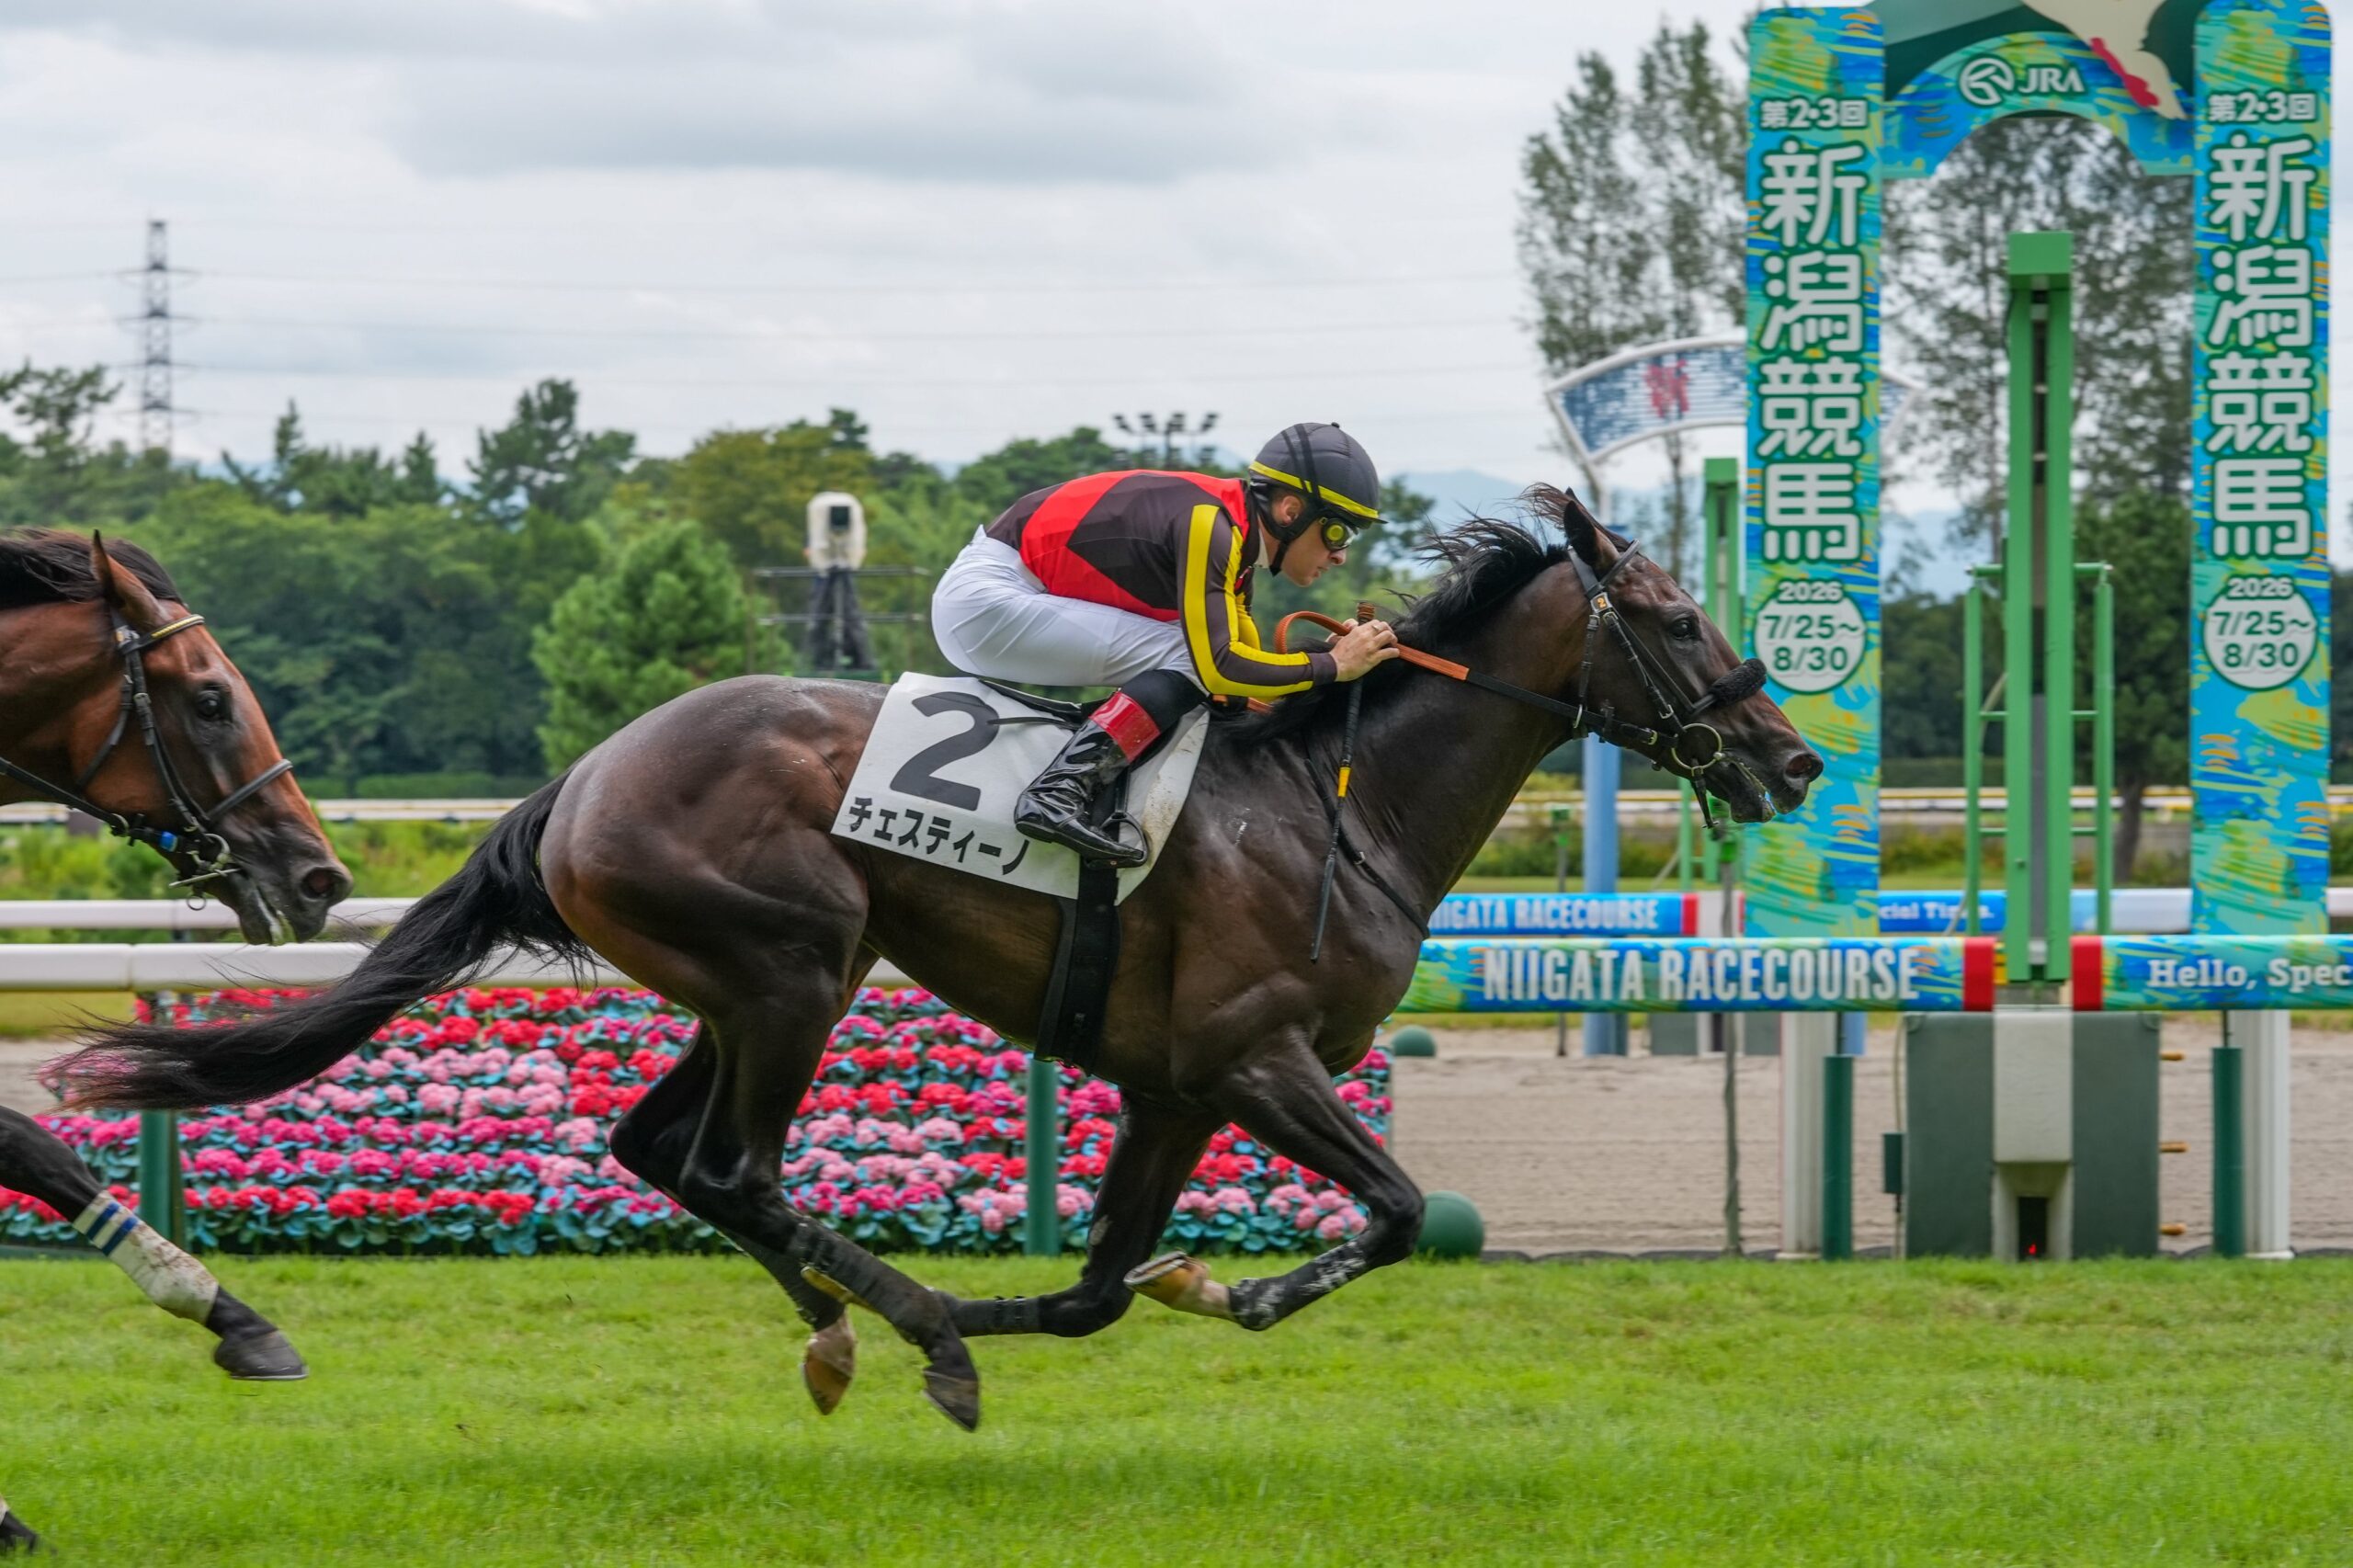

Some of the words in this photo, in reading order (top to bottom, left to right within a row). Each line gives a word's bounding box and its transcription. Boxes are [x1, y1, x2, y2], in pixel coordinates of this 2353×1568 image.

[2018, 67, 2085, 93] JRA
[1756, 140, 1866, 560] 新潟競馬
[2205, 134, 2315, 556] 新潟競馬
[1779, 581, 1844, 600] 2026
[2228, 577, 2294, 597] 2026
[1774, 646, 1847, 671] 8/30
[2224, 642, 2299, 667] 8/30
[890, 691, 1000, 812] 2
[848, 796, 1030, 876] チェスティーノ
[1428, 900, 1508, 929] IIGATA
[1515, 899, 1659, 929] RACECOURSE
[1483, 949, 1645, 1001] NIIGATA
[1659, 949, 1919, 1001] RACECOURSE
[2146, 959, 2257, 991] Hello,
[2267, 958, 2353, 994] Spec
